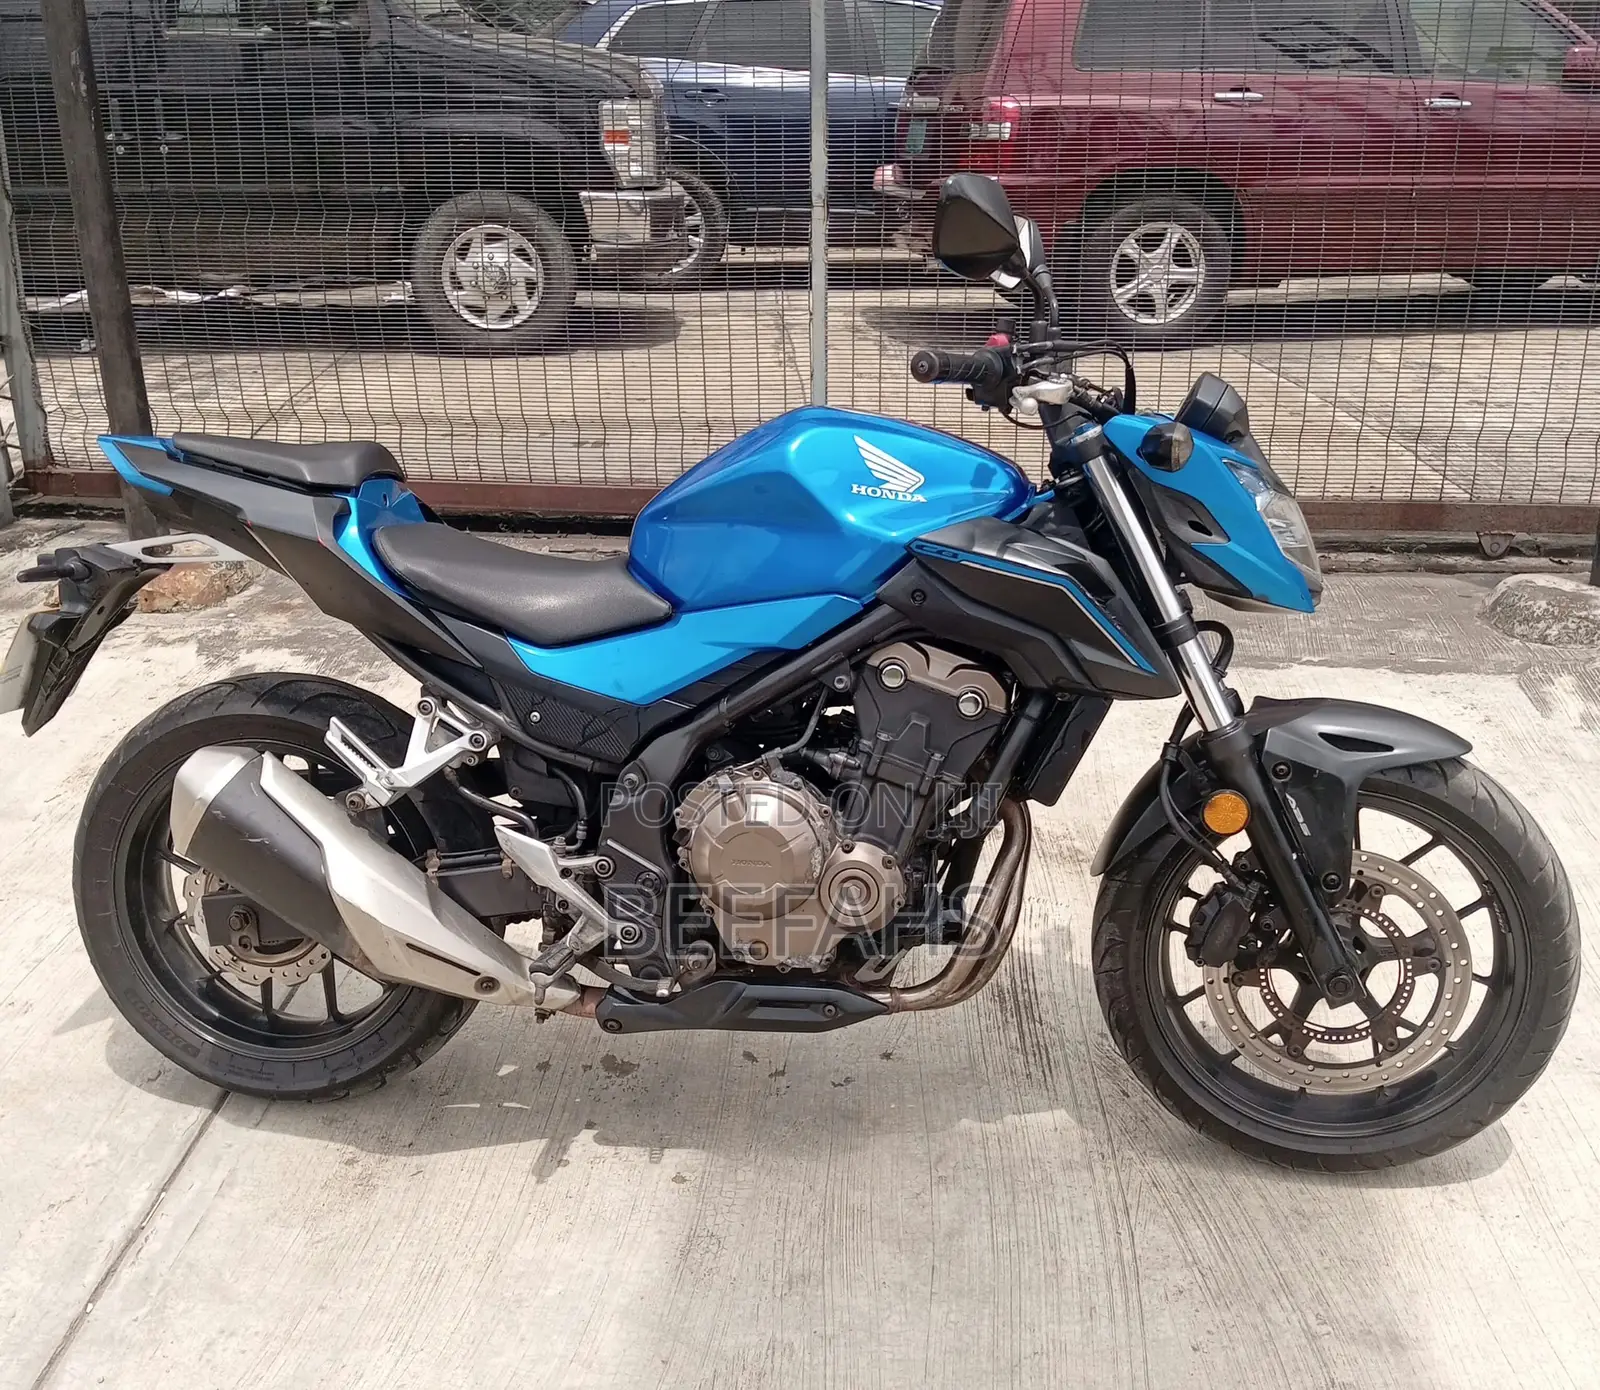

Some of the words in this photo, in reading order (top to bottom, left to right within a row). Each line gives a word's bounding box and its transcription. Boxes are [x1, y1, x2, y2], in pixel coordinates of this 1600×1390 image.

[851, 483, 928, 503] HONDA
[1285, 792, 1312, 837] ABS
[730, 859, 773, 868] HONDA
